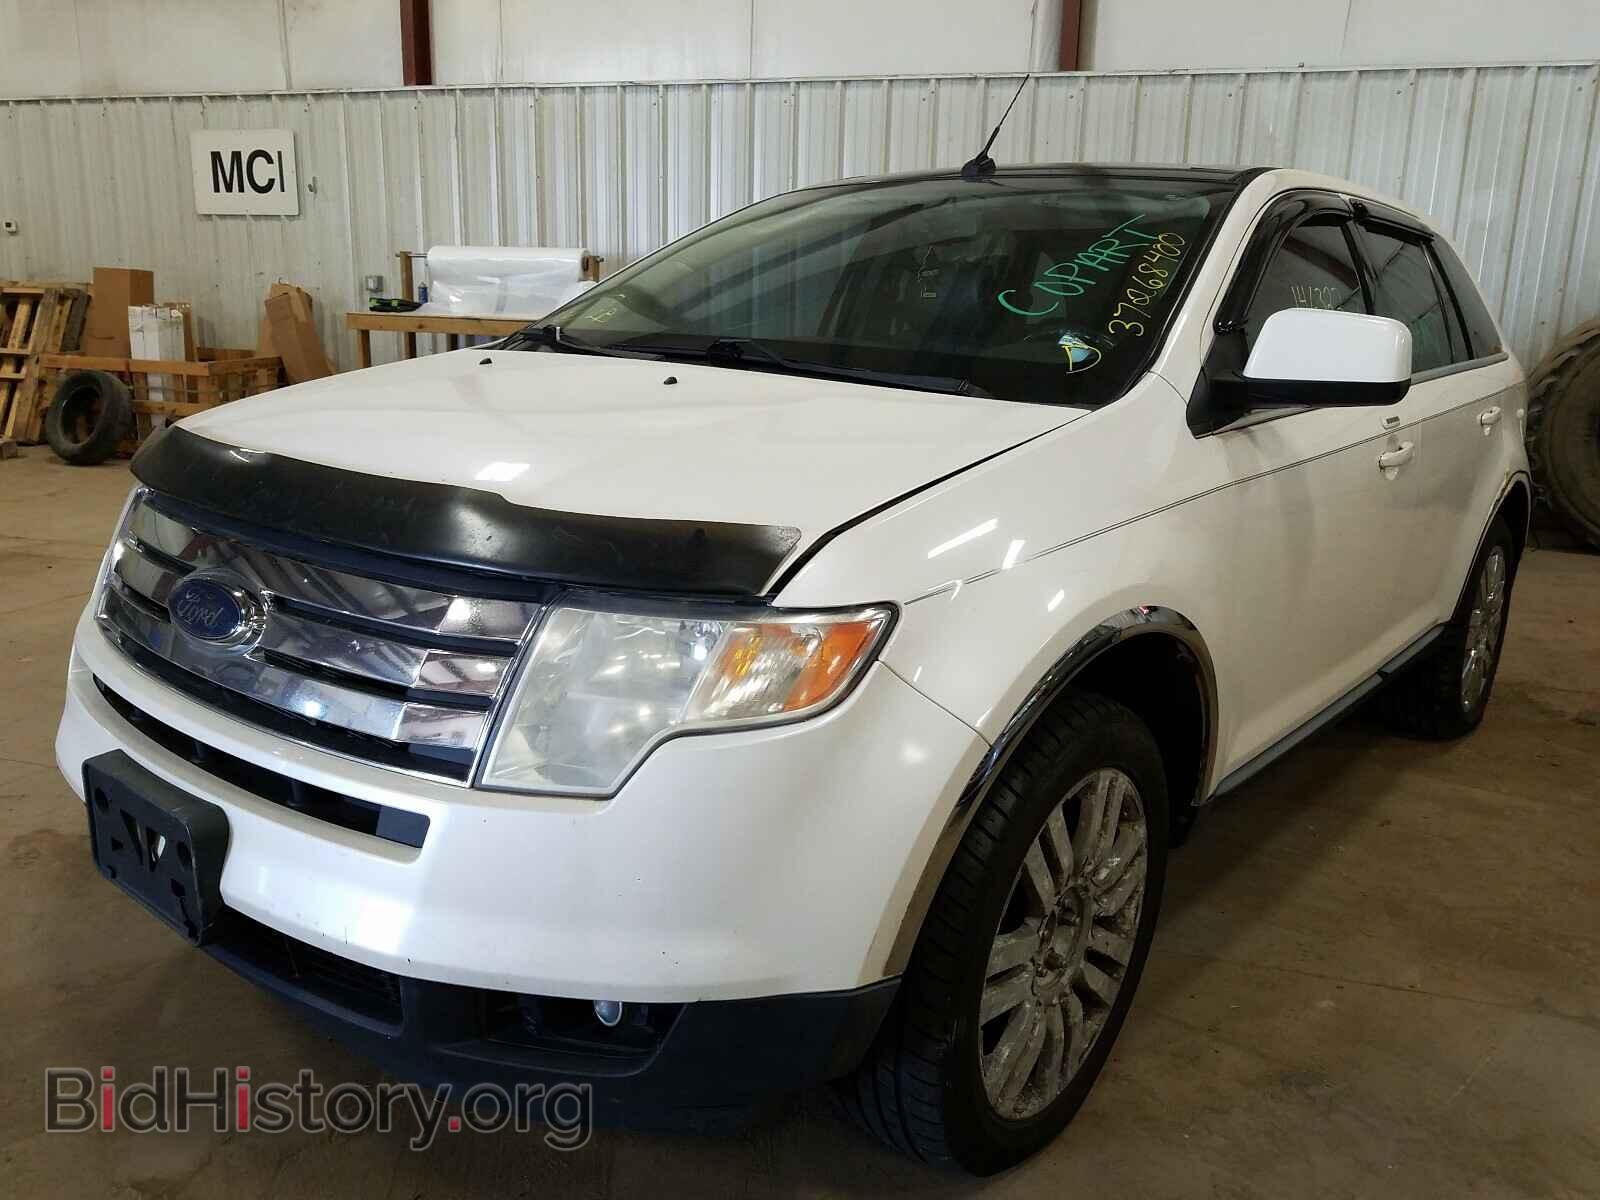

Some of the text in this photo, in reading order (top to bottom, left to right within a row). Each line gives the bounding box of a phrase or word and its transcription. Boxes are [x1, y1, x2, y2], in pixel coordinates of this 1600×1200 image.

[210, 149, 285, 194] MCI
[998, 214, 1157, 316] COPART
[177, 589, 224, 625] Ford
